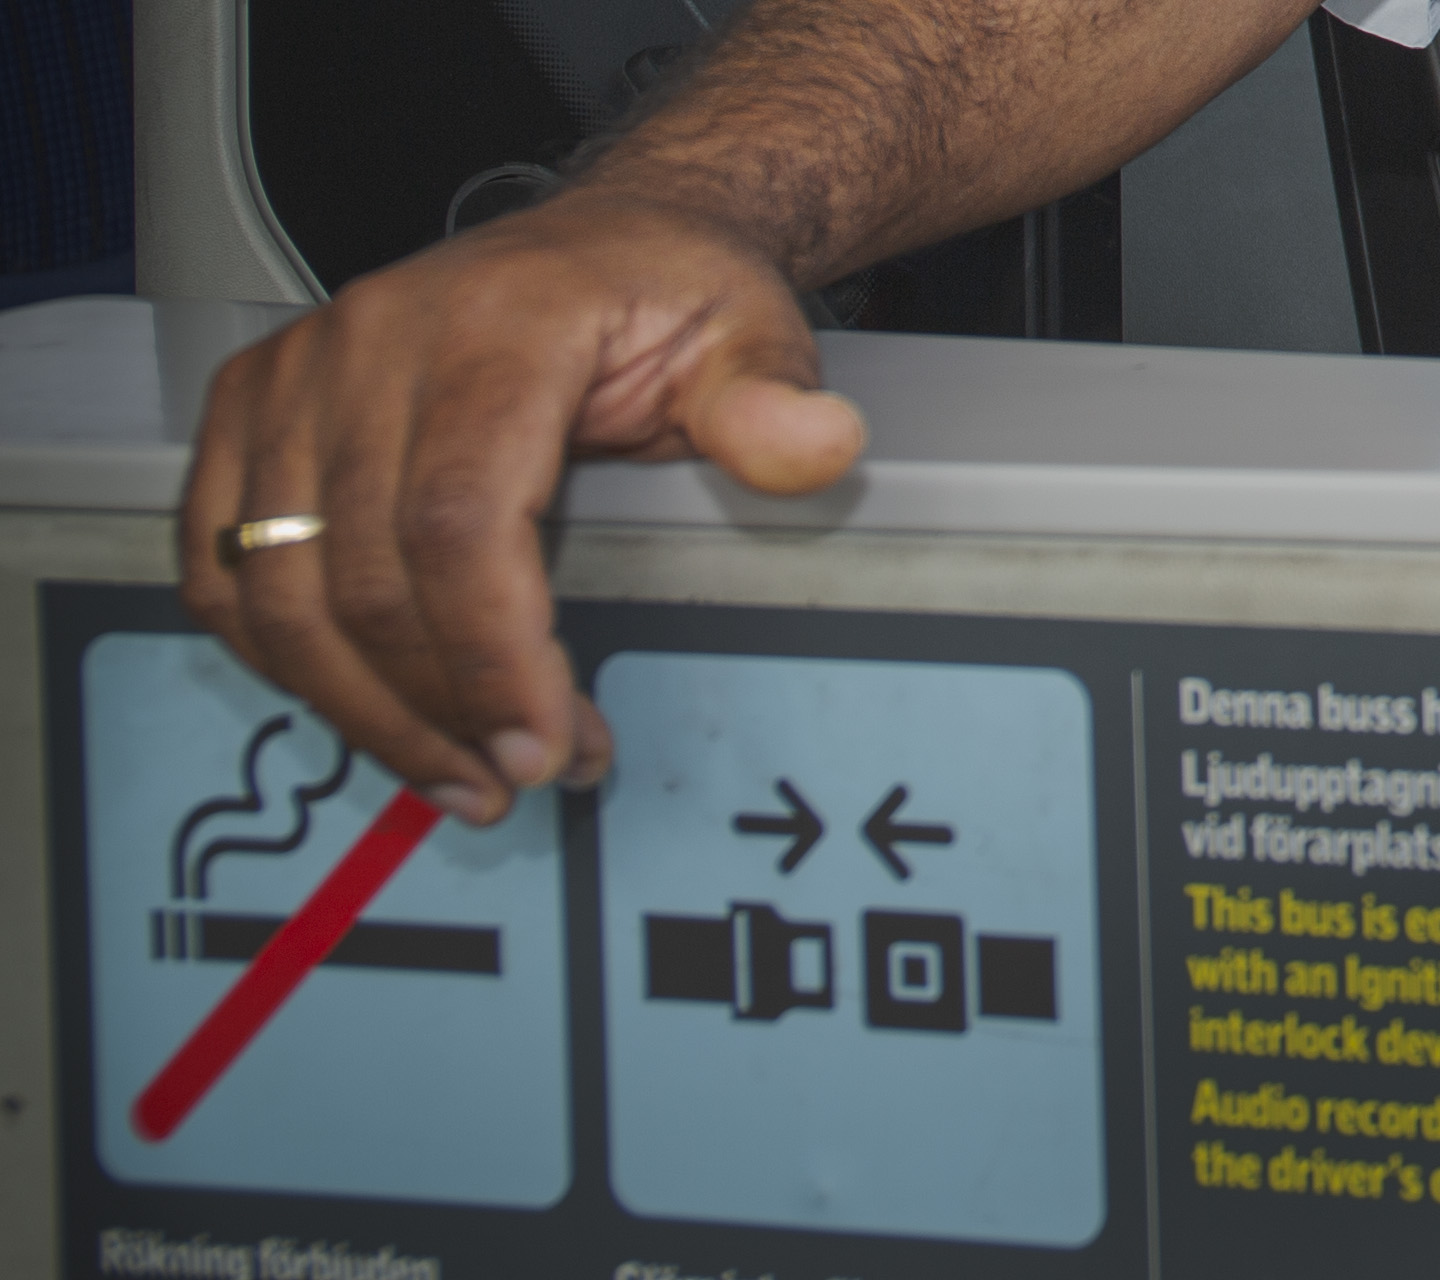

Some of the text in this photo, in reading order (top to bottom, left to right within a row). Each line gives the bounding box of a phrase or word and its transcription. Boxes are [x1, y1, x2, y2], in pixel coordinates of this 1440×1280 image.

[1179, 678, 1313, 731] Denna
[1318, 682, 1417, 736] buss
[1182, 813, 1245, 861] vid
[1184, 883, 1274, 935] This
[1279, 887, 1355, 939] bus
[1362, 892, 1398, 941] is
[1186, 947, 1278, 996] with
[1284, 959, 1337, 999] an
[1189, 1005, 1370, 1063] interlock
[1191, 1079, 1310, 1132] Audio
[1192, 1143, 1261, 1190] the
[1267, 1146, 1424, 1203] driver's
